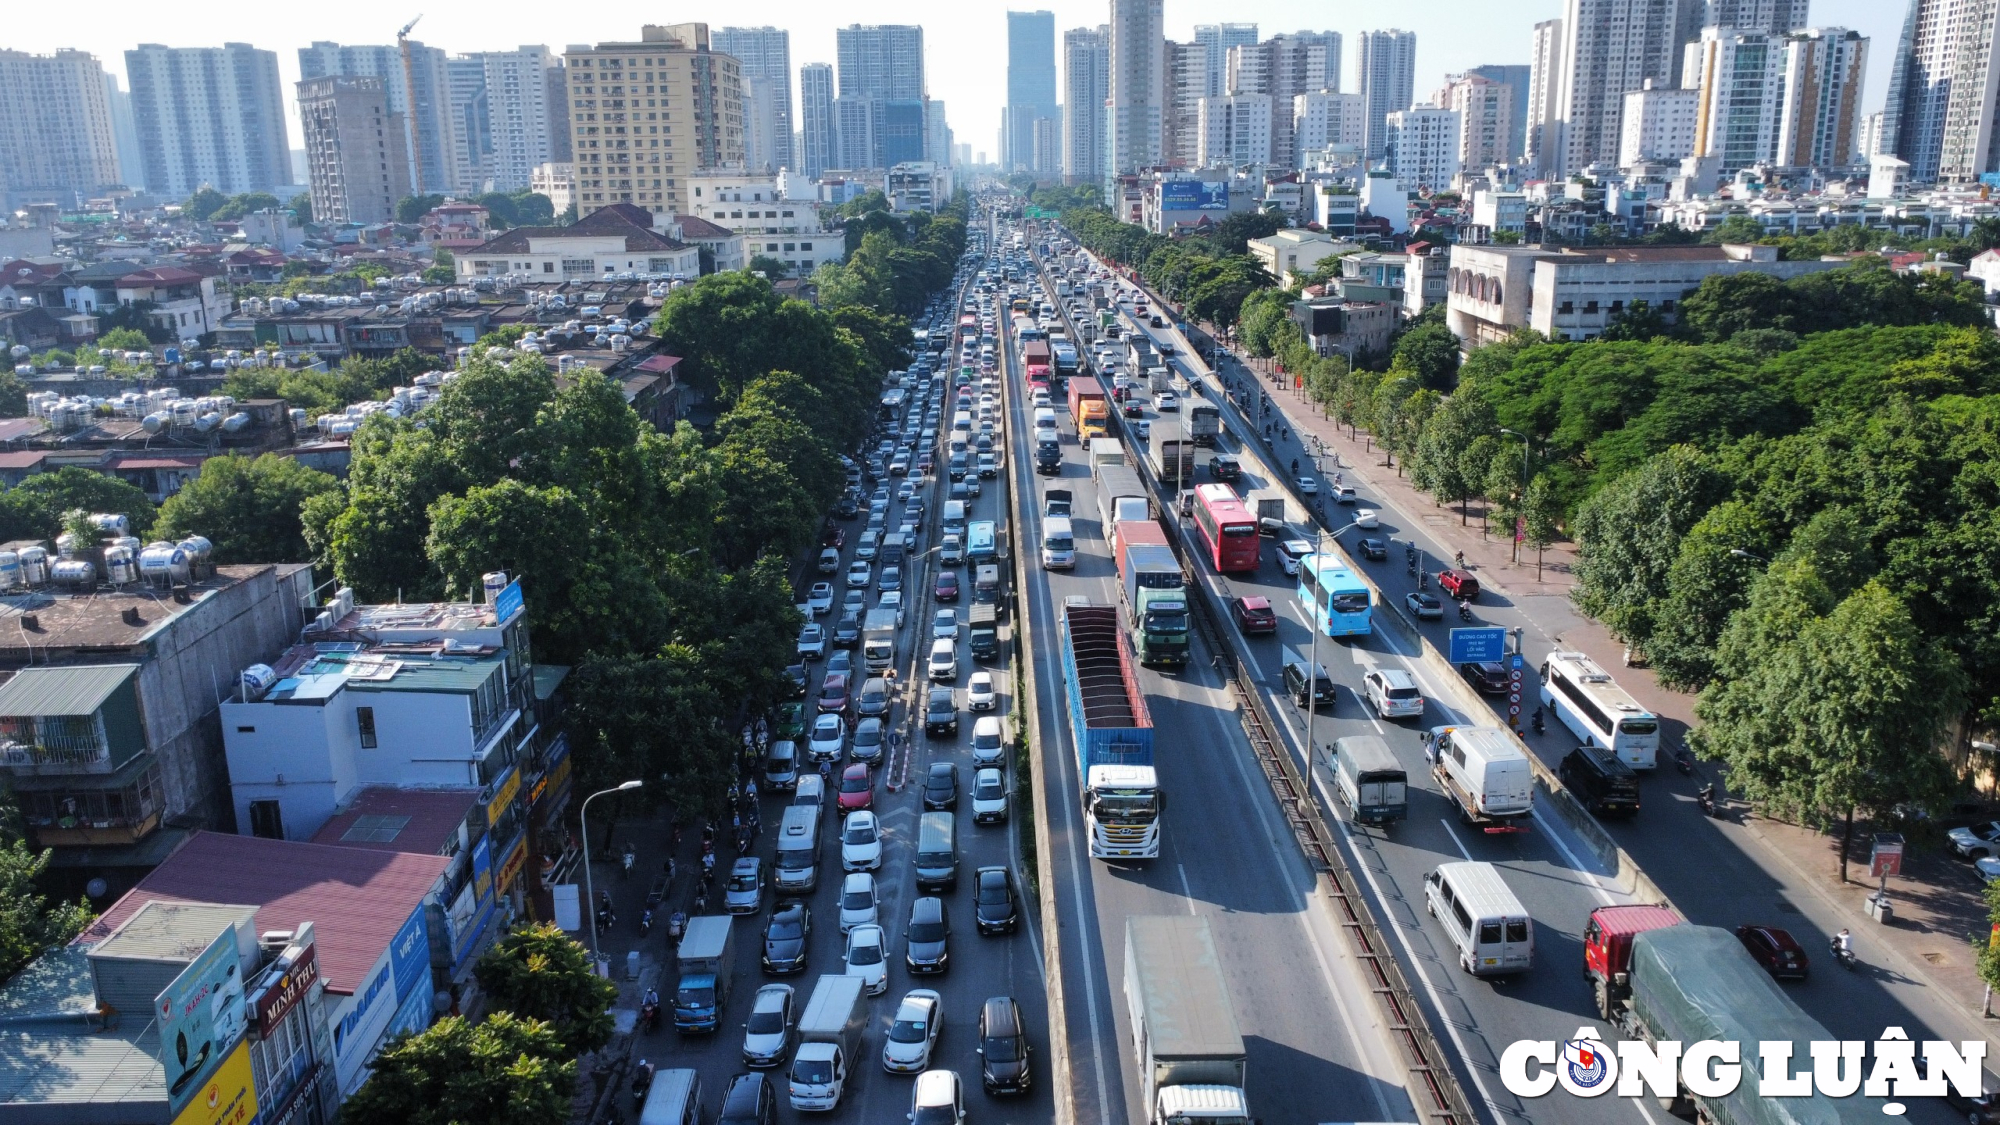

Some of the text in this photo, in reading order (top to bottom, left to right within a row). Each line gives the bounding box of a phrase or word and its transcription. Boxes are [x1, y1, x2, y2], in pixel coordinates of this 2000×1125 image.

[399, 931, 416, 959] VIỆT
[266, 983, 295, 1024] MINH
[295, 958, 317, 990] THU
[347, 961, 390, 1036] DAIKIN
[278, 1106, 294, 1125] RANG
[304, 1078, 315, 1097] CAO
